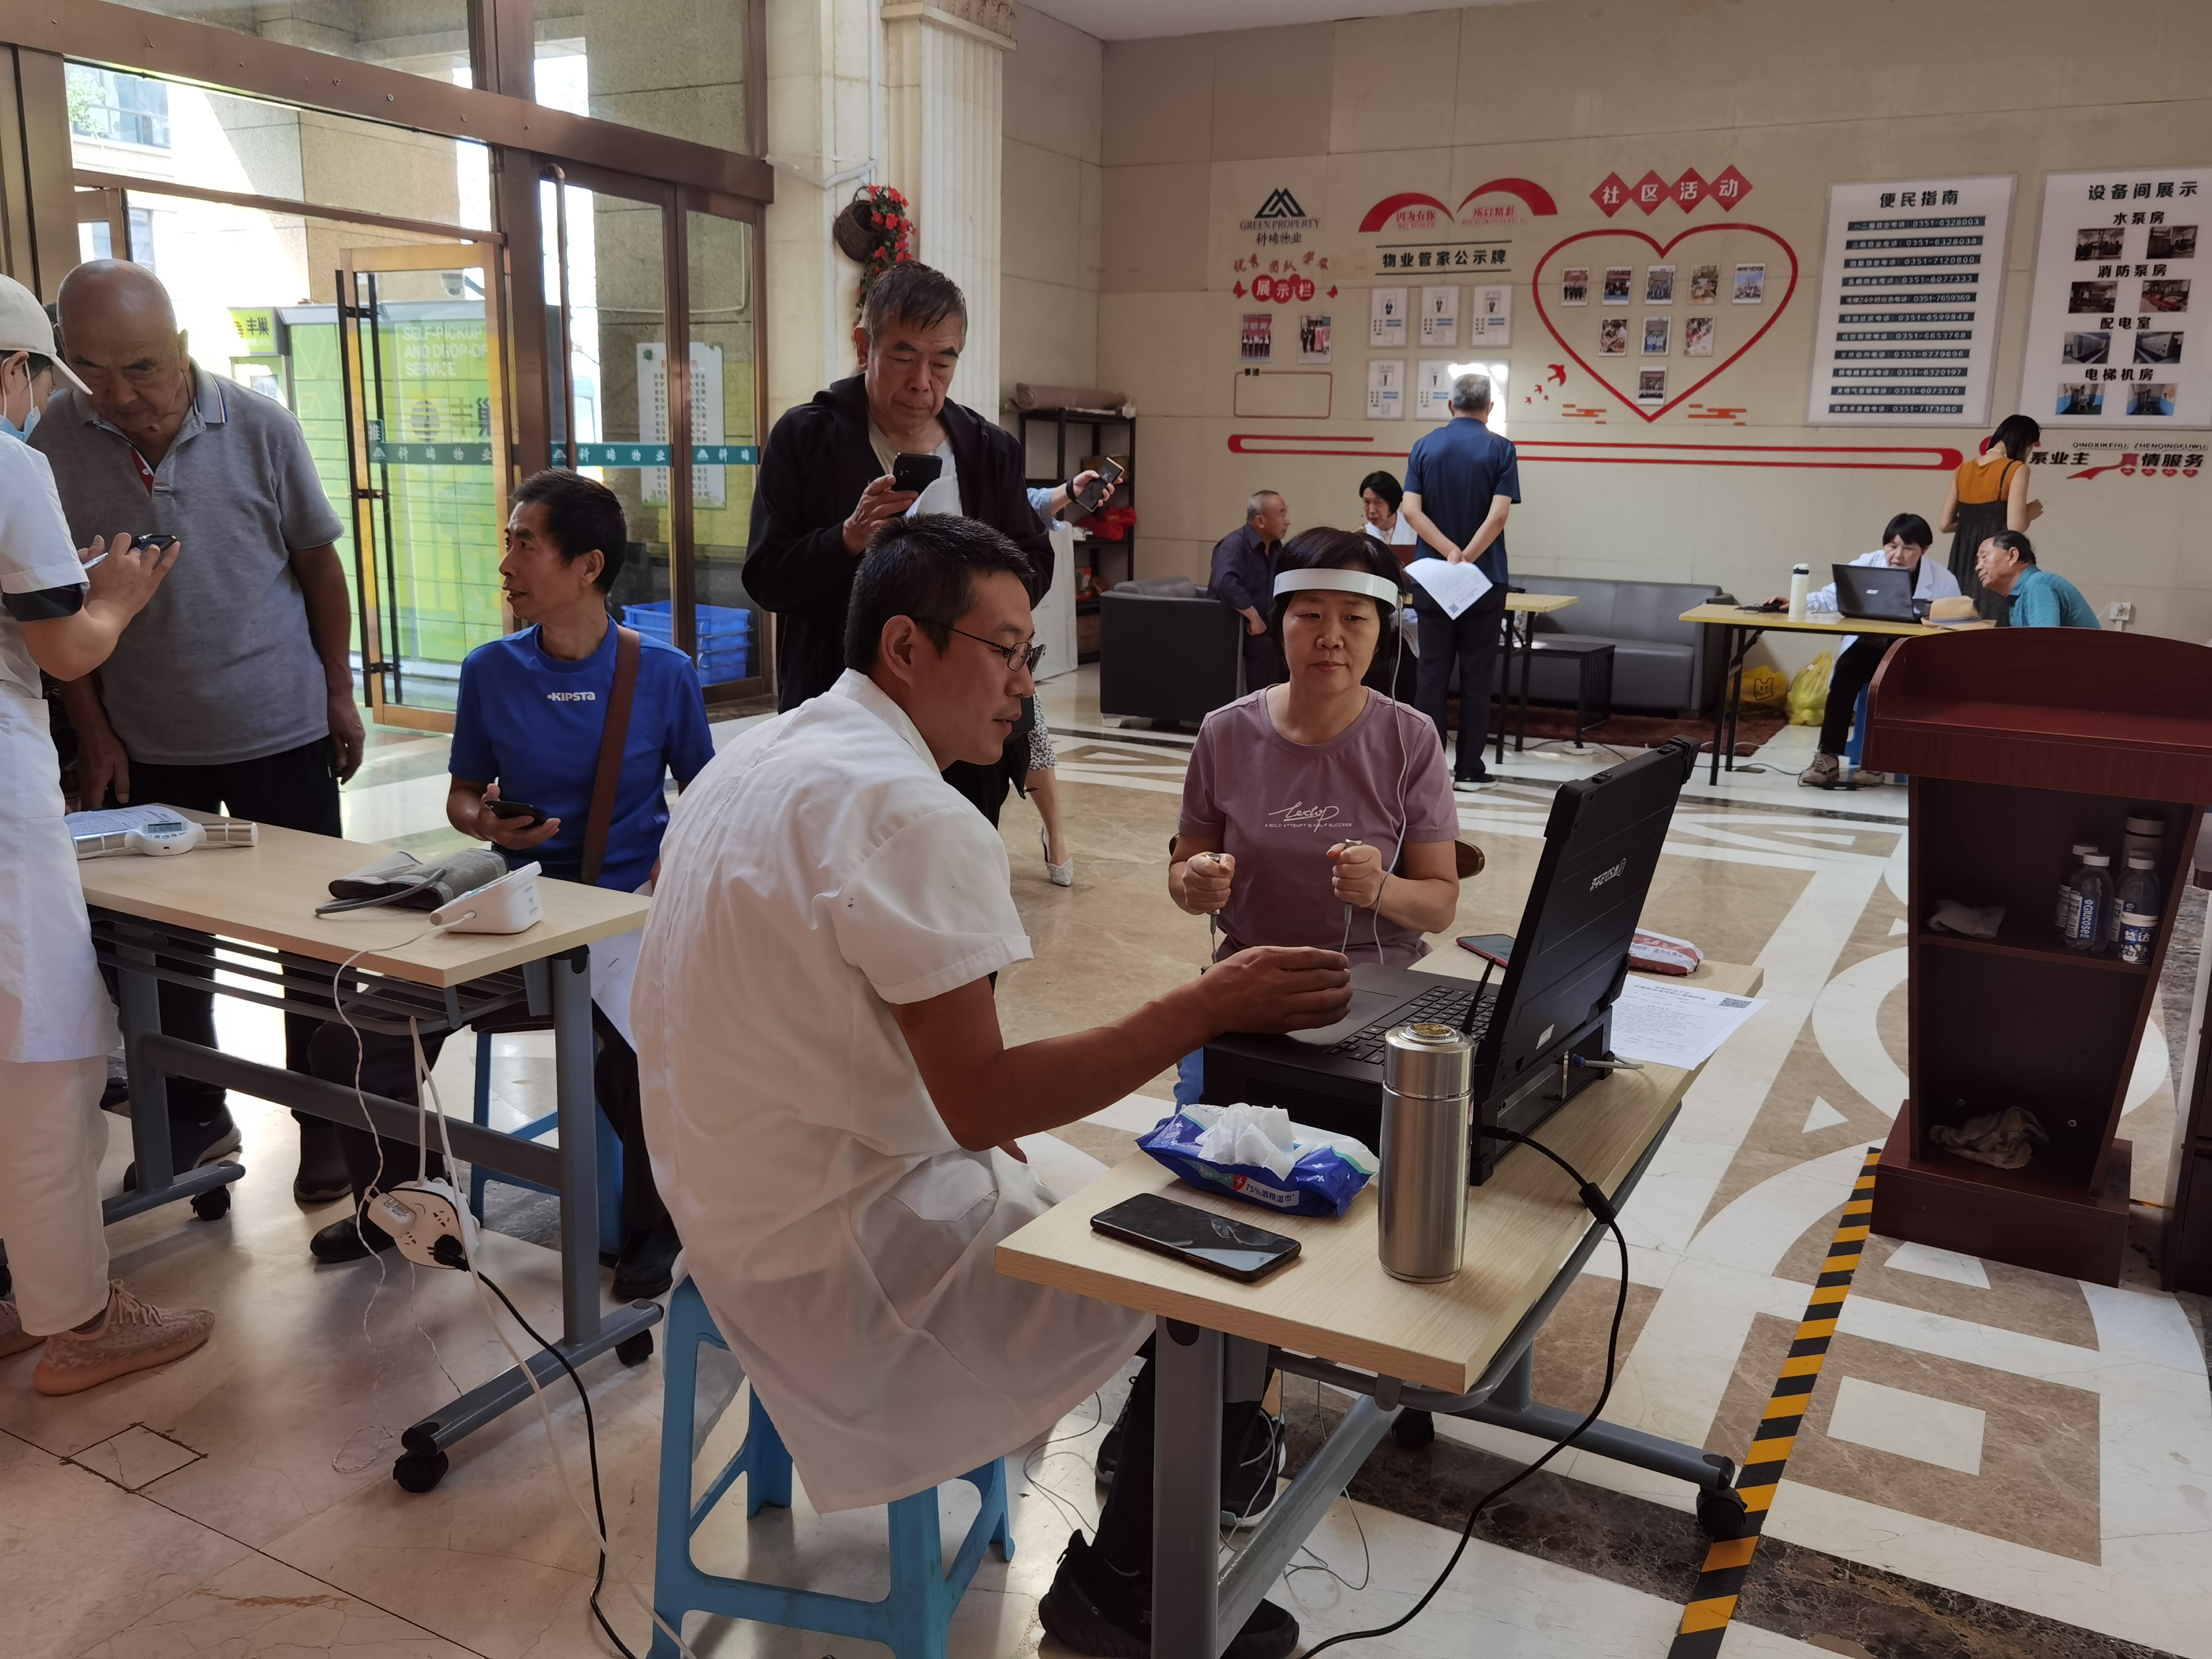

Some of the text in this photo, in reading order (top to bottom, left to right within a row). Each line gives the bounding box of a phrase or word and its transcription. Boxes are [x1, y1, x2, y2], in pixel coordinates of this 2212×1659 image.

[1602, 179, 1738, 204] 社区活动
[2088, 181, 2198, 200] 设备间展示
[1880, 189, 1959, 208] 便民指南
[1396, 210, 1435, 222] 因为有你
[2113, 211, 2165, 225] 水泵房
[1240, 219, 1320, 231] GREEN PROPERTY
[1382, 249, 1507, 268] 物业管家公示牌
[2098, 264, 2167, 278] 消防泵房
[1257, 280, 1311, 299] 展示栏
[246, 317, 269, 335] 丰巢
[2100, 316, 2151, 329] 配电室
[403, 325, 482, 341] SELF-PICKUP
[406, 345, 430, 358] AND
[406, 361, 456, 376] SERVICE
[2085, 368, 2154, 381] 电梯机房
[551, 691, 596, 702] KIPSTA
[2125, 930, 2151, 942] 益达
